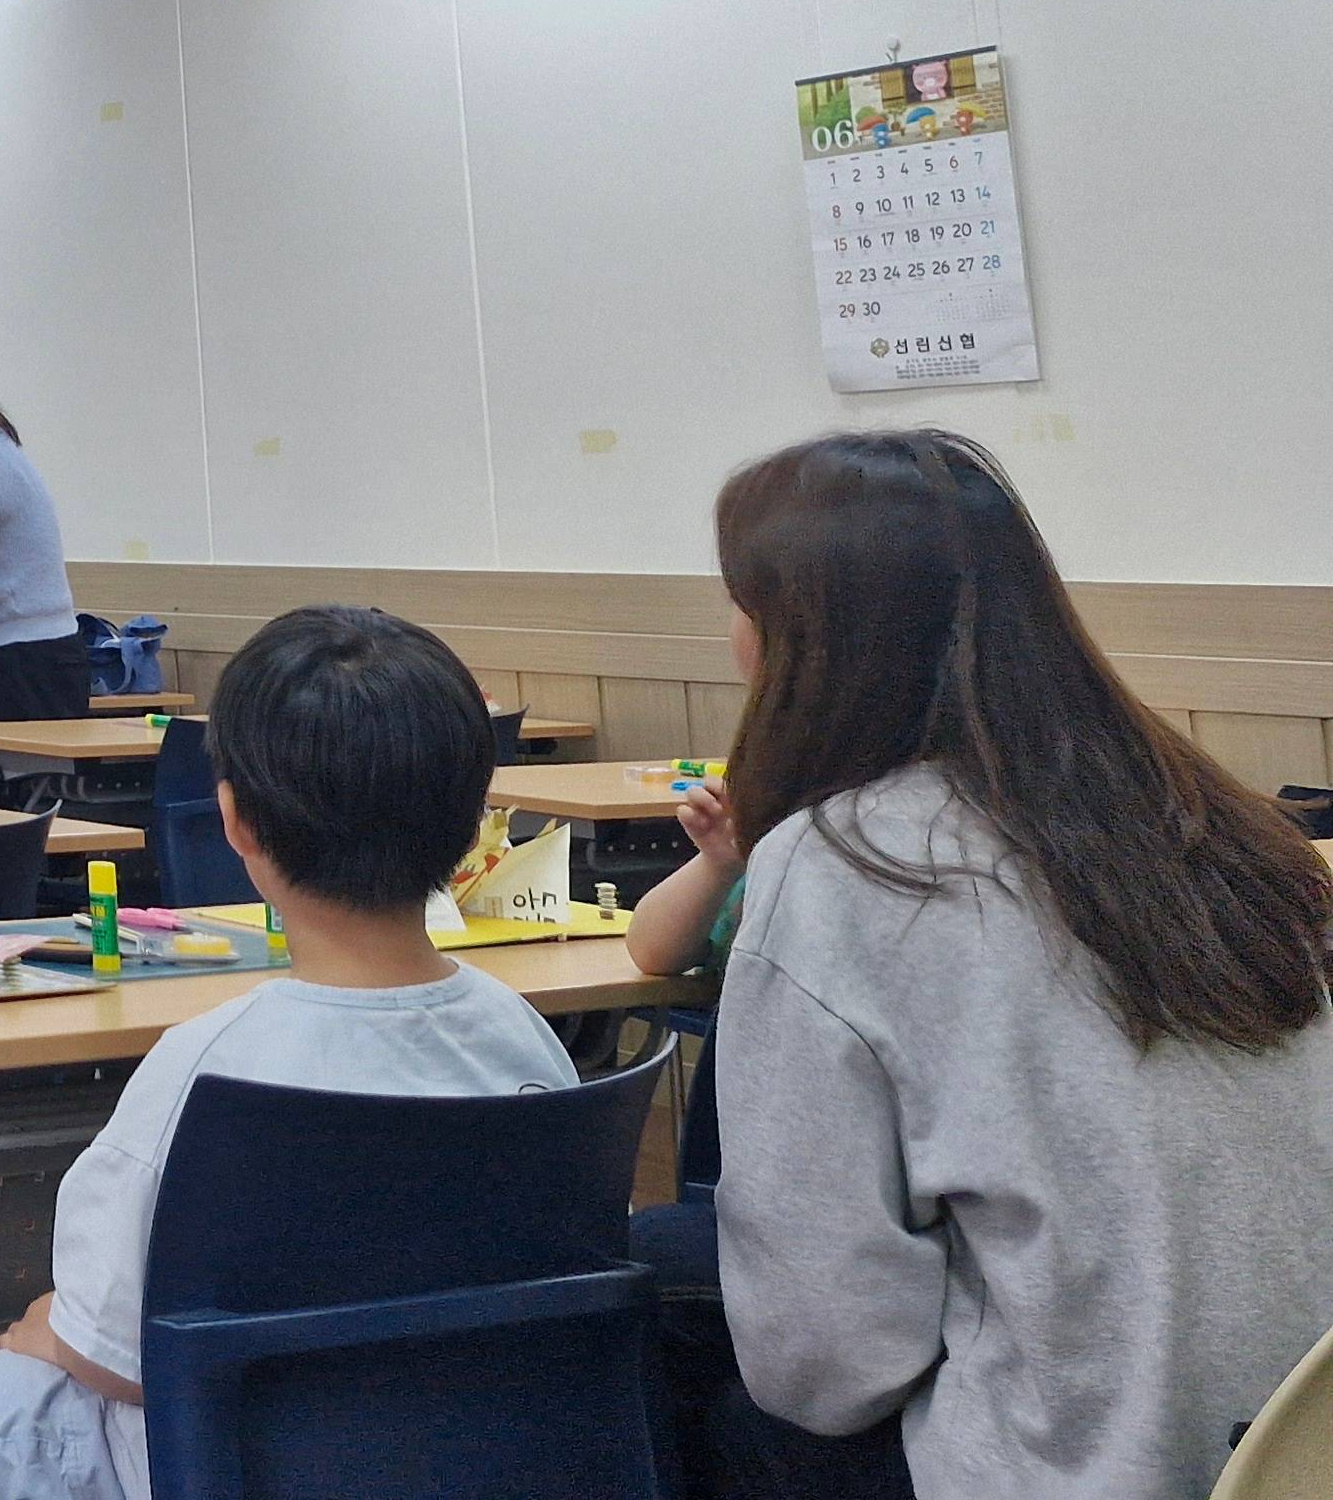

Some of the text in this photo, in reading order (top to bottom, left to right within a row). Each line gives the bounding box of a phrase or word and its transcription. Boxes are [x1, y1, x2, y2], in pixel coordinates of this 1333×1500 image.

[812, 120, 854, 152] 06
[830, 151, 983, 185] 1 2 3 4 5 6 7
[833, 186, 991, 219] 8 9 10 11 12 13 14
[834, 220, 996, 252] 15 16 17 18 19 20 21
[835, 254, 1001, 286] 22 23 24 25 26 27 28
[839, 301, 881, 319] 29 30
